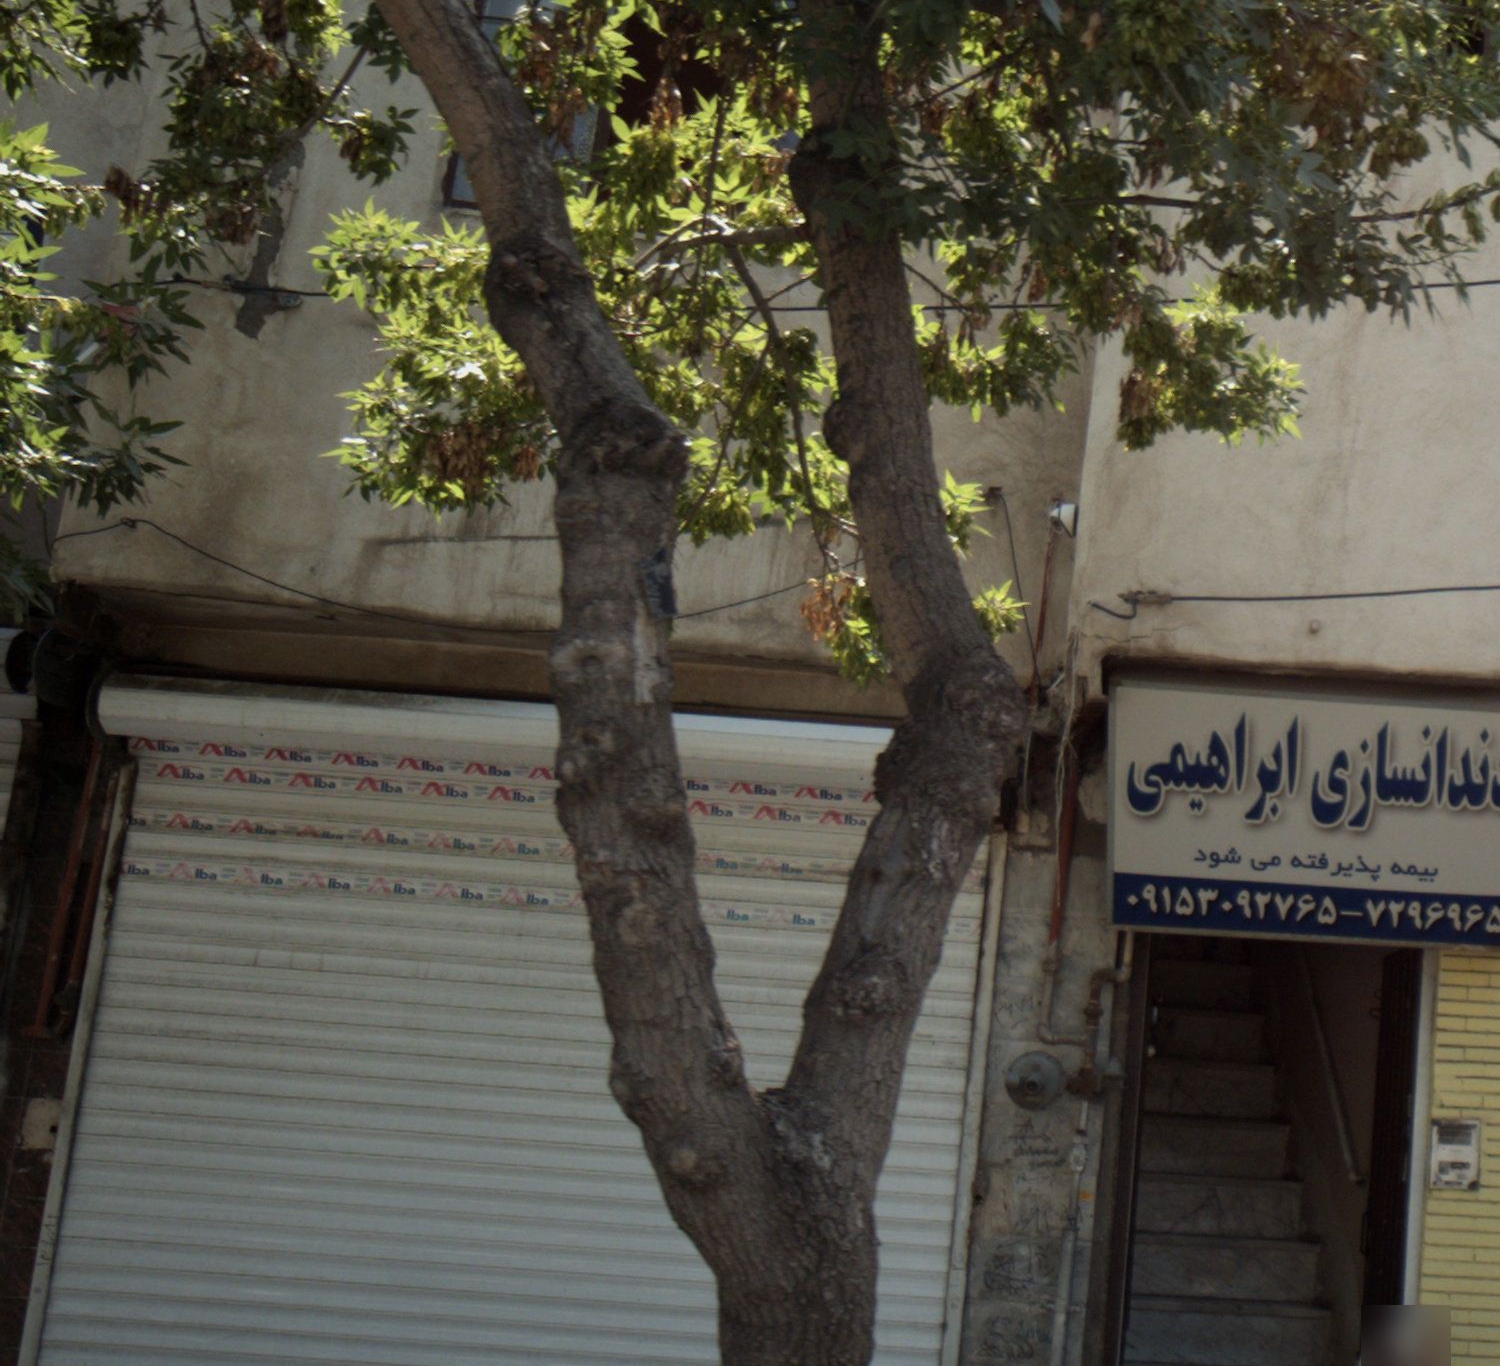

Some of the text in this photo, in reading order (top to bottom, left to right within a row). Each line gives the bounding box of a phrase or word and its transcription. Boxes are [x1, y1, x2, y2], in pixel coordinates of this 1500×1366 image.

[1127, 713, 1299, 821] ابراهیمی
[1194, 848, 1438, 882] بیمه پذیرفته می شود
